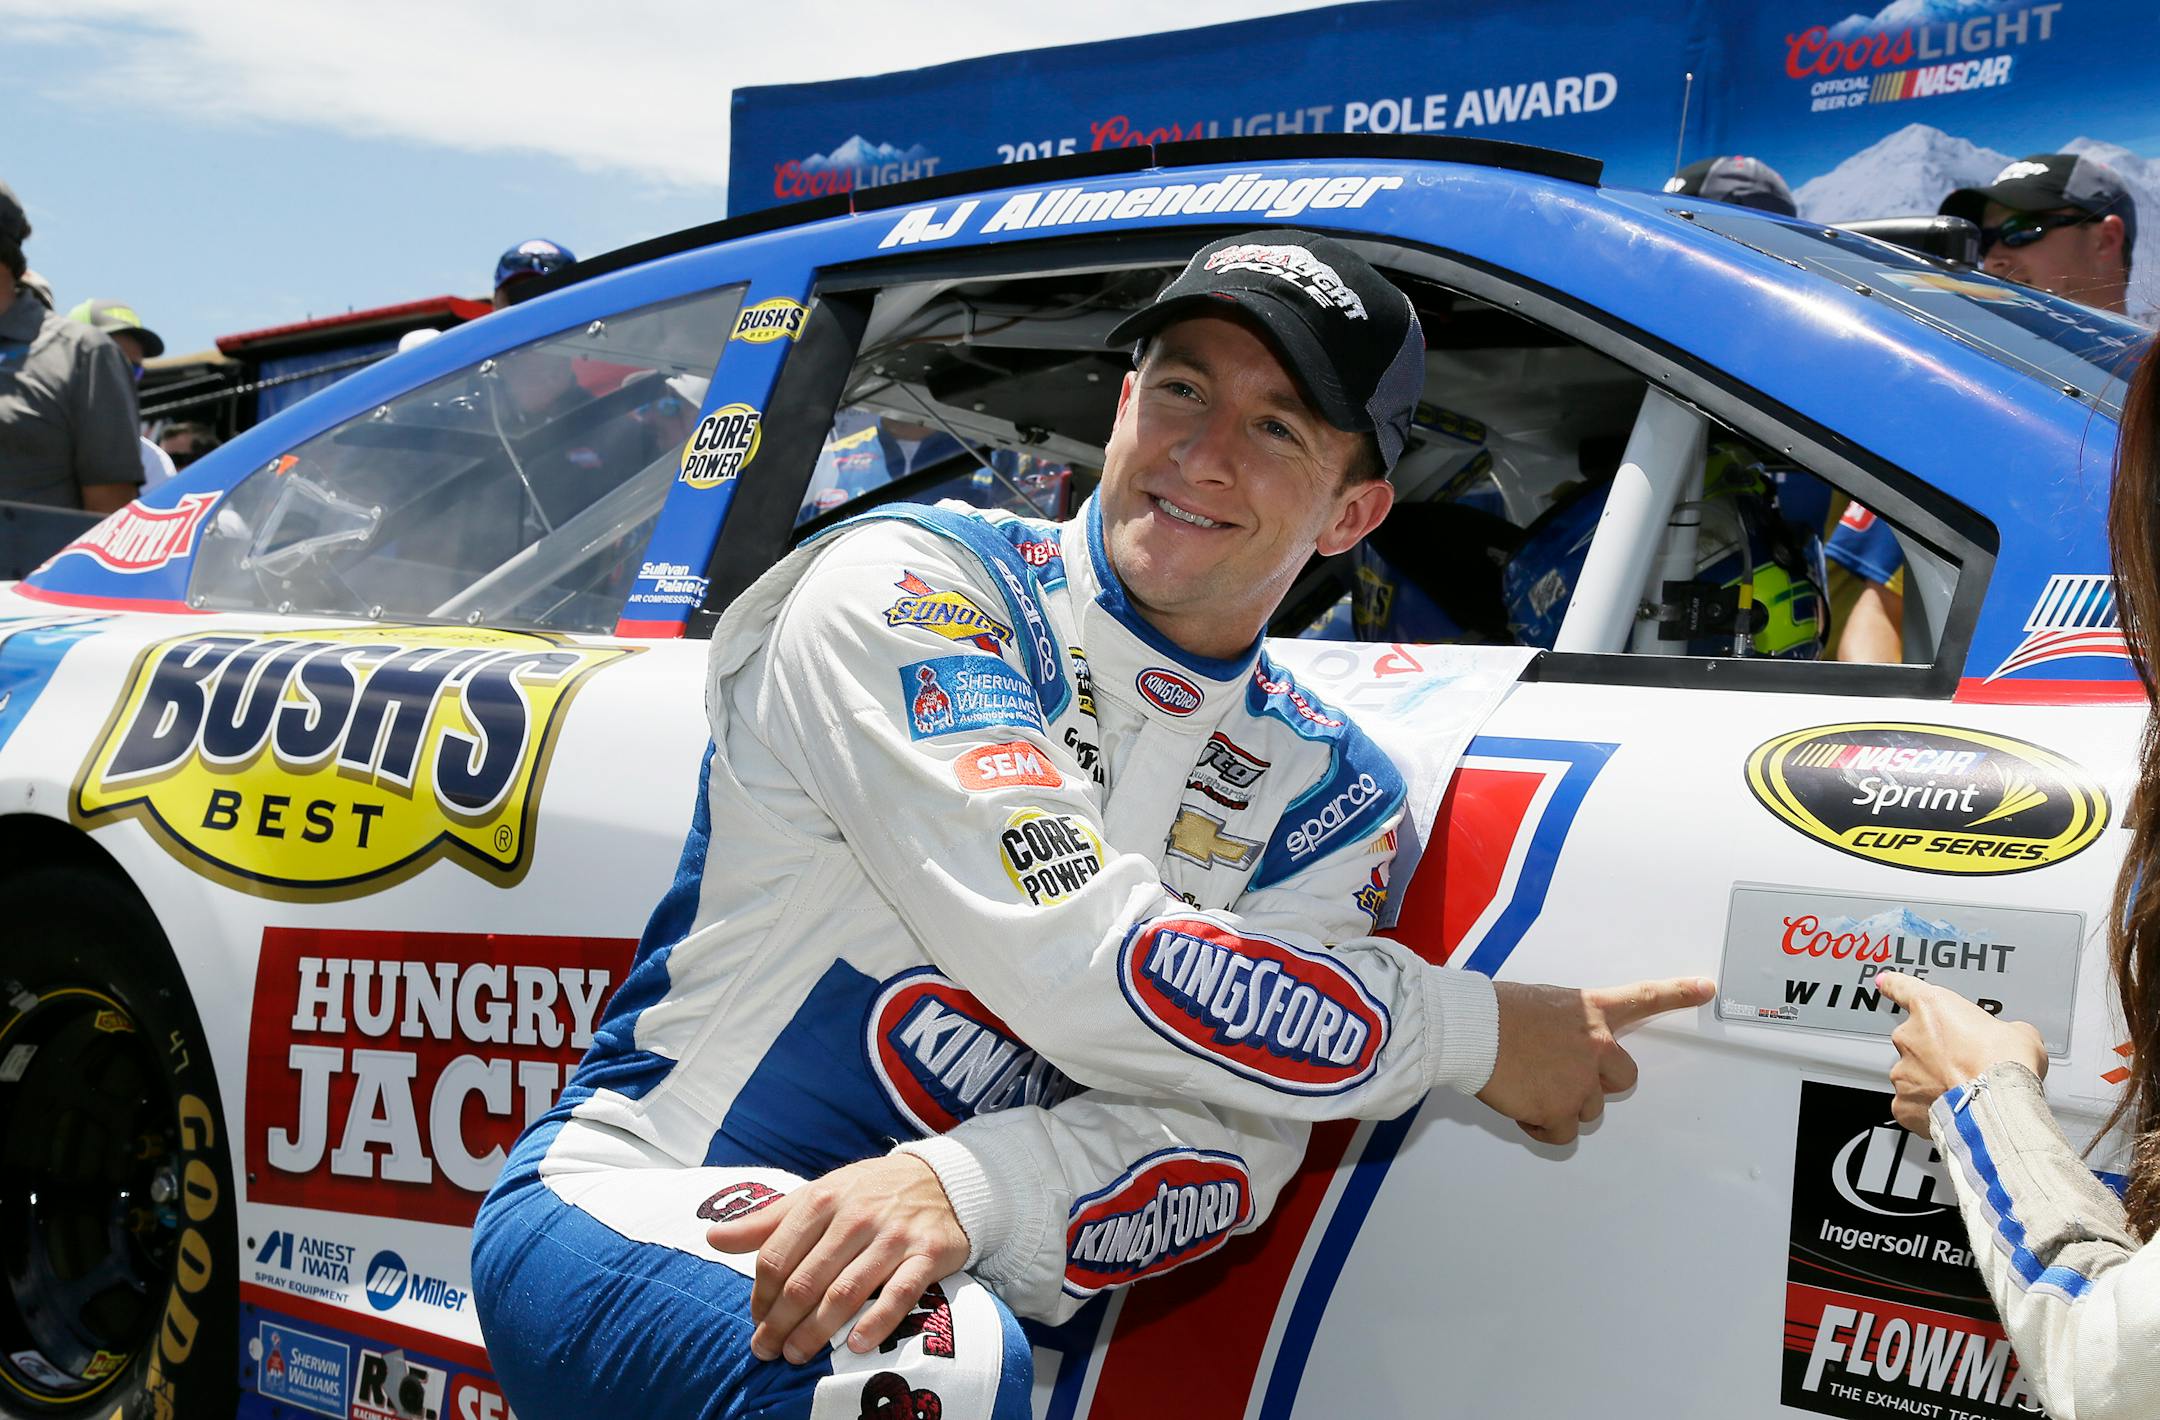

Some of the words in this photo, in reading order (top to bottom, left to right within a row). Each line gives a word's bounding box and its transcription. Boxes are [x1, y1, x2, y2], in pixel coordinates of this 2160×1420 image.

[1785, 26, 1916, 78] Coors
[1918, 3, 2062, 60] LIGHT
[1811, 76, 1870, 96] OFFICIAL
[1912, 55, 2012, 98] NASCAR
[1344, 95, 1447, 134] POLE
[1454, 72, 1618, 127] AWARD
[1811, 94, 1848, 112] BEER
[1849, 92, 1868, 107] OF
[774, 160, 854, 198] Coors
[856, 157, 940, 192] LIGHT
[877, 200, 981, 249] AJ
[980, 173, 1404, 234] Allmendinger
[1216, 262, 1336, 309] POLE
[1294, 262, 1369, 321] LIGHT
[737, 307, 804, 333] BUSH'S
[694, 413, 760, 451] CORE
[680, 452, 744, 482] POWER
[640, 562, 690, 576] Sullivan
[628, 594, 642, 603] AIR
[642, 594, 702, 608] COMPRESSORS
[654, 579, 705, 597] Palatek
[991, 556, 1056, 684] sparco
[956, 670, 1032, 697] SHERWIN
[1145, 674, 1198, 711] KINGSFORD
[956, 691, 1040, 718] WILLIAMS
[960, 711, 1014, 723] Automotive
[102, 637, 584, 816] BUSH'S
[977, 752, 1044, 780] SEM
[1849, 745, 1978, 776] NASCAR
[1852, 776, 1981, 815] Sprint
[201, 789, 384, 849] BEST
[1287, 773, 1377, 856] sparco
[1001, 815, 1091, 871] CORE
[1851, 831, 1920, 851] CUP
[1924, 838, 2050, 862] SERIES
[1781, 914, 1891, 963] Coors
[1896, 936, 2016, 974] LIGHT
[292, 957, 610, 1050] HUNGRY
[1149, 933, 1370, 1066] KINGSFORD
[1071, 1182, 1239, 1268] KINGSFORD
[1819, 1219, 1931, 1262] Ingersoll
[299, 1236, 356, 1265] ANEST
[255, 1272, 286, 1289] SPRAY
[288, 1280, 350, 1304] EQUIPMENT
[303, 1256, 350, 1285] IWATA
[408, 1273, 468, 1312] Miller
[290, 1347, 341, 1377] SHERWIN
[288, 1366, 341, 1396] WILLIAMS
[1829, 1382, 1862, 1402] THE
[1865, 1391, 1944, 1418] EXHAUST
